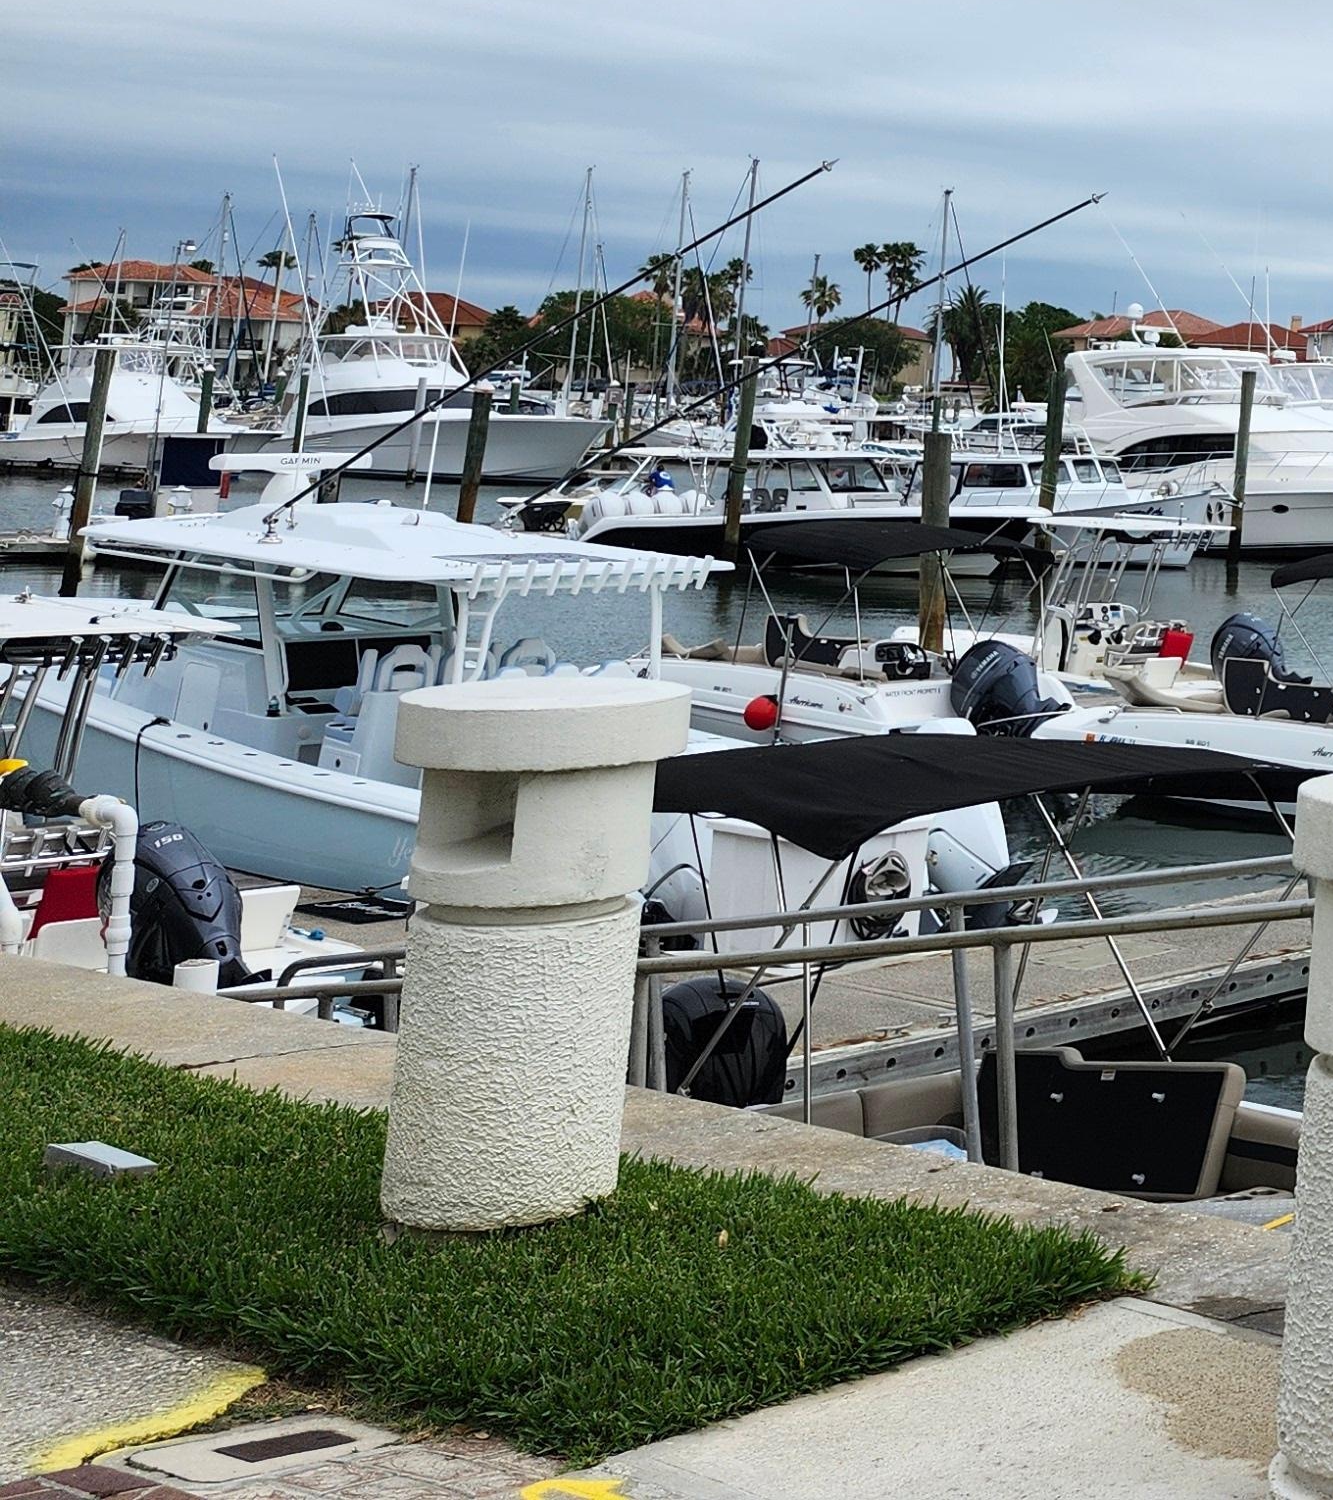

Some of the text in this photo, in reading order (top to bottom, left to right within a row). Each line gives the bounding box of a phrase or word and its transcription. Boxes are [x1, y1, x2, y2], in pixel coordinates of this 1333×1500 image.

[975, 650, 1000, 674] YAMAHA
[789, 695, 824, 709] Hurricane
[154, 833, 184, 849] 150
